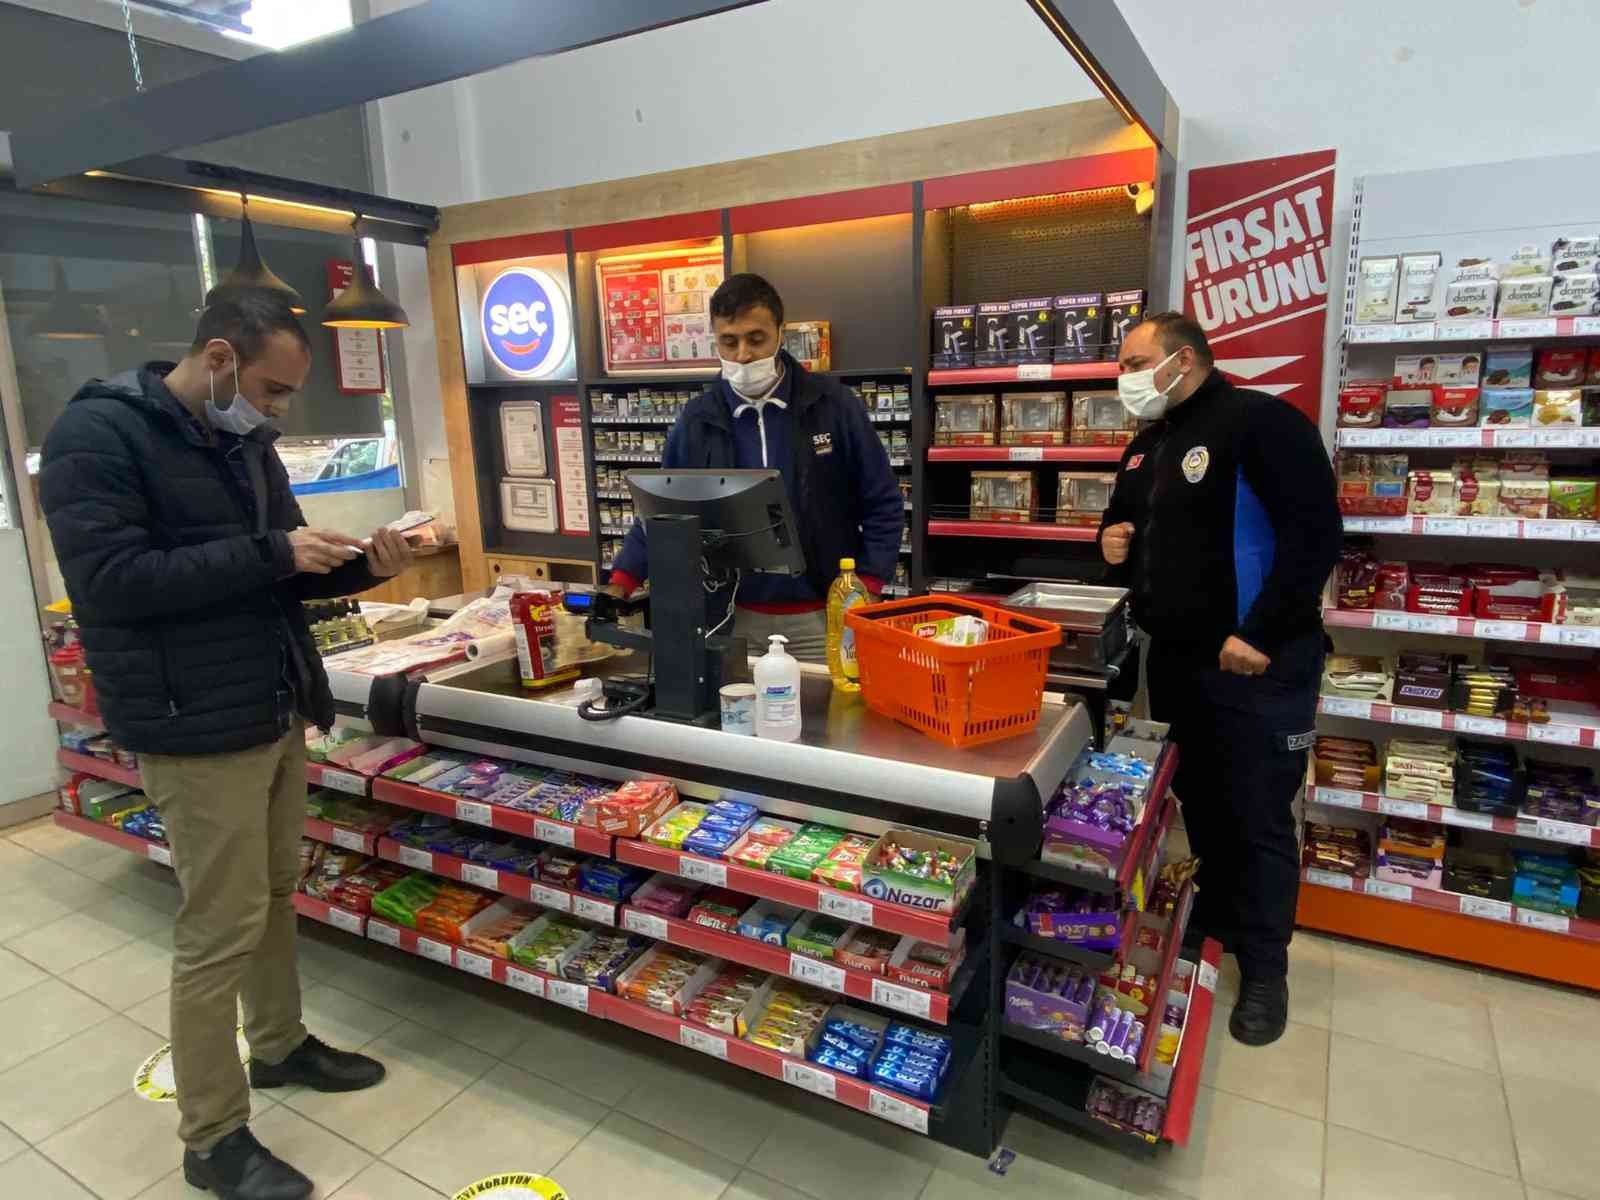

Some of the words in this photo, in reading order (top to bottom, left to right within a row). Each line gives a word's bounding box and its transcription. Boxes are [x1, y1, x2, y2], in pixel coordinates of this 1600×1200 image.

[1184, 186, 1324, 281] FIRSAT
[1191, 239, 1329, 332] ÜRÜNÜ
[489, 300, 548, 337] seç
[887, 887, 946, 910] Nazar
[477, 1175, 532, 1192] KORUYUN
